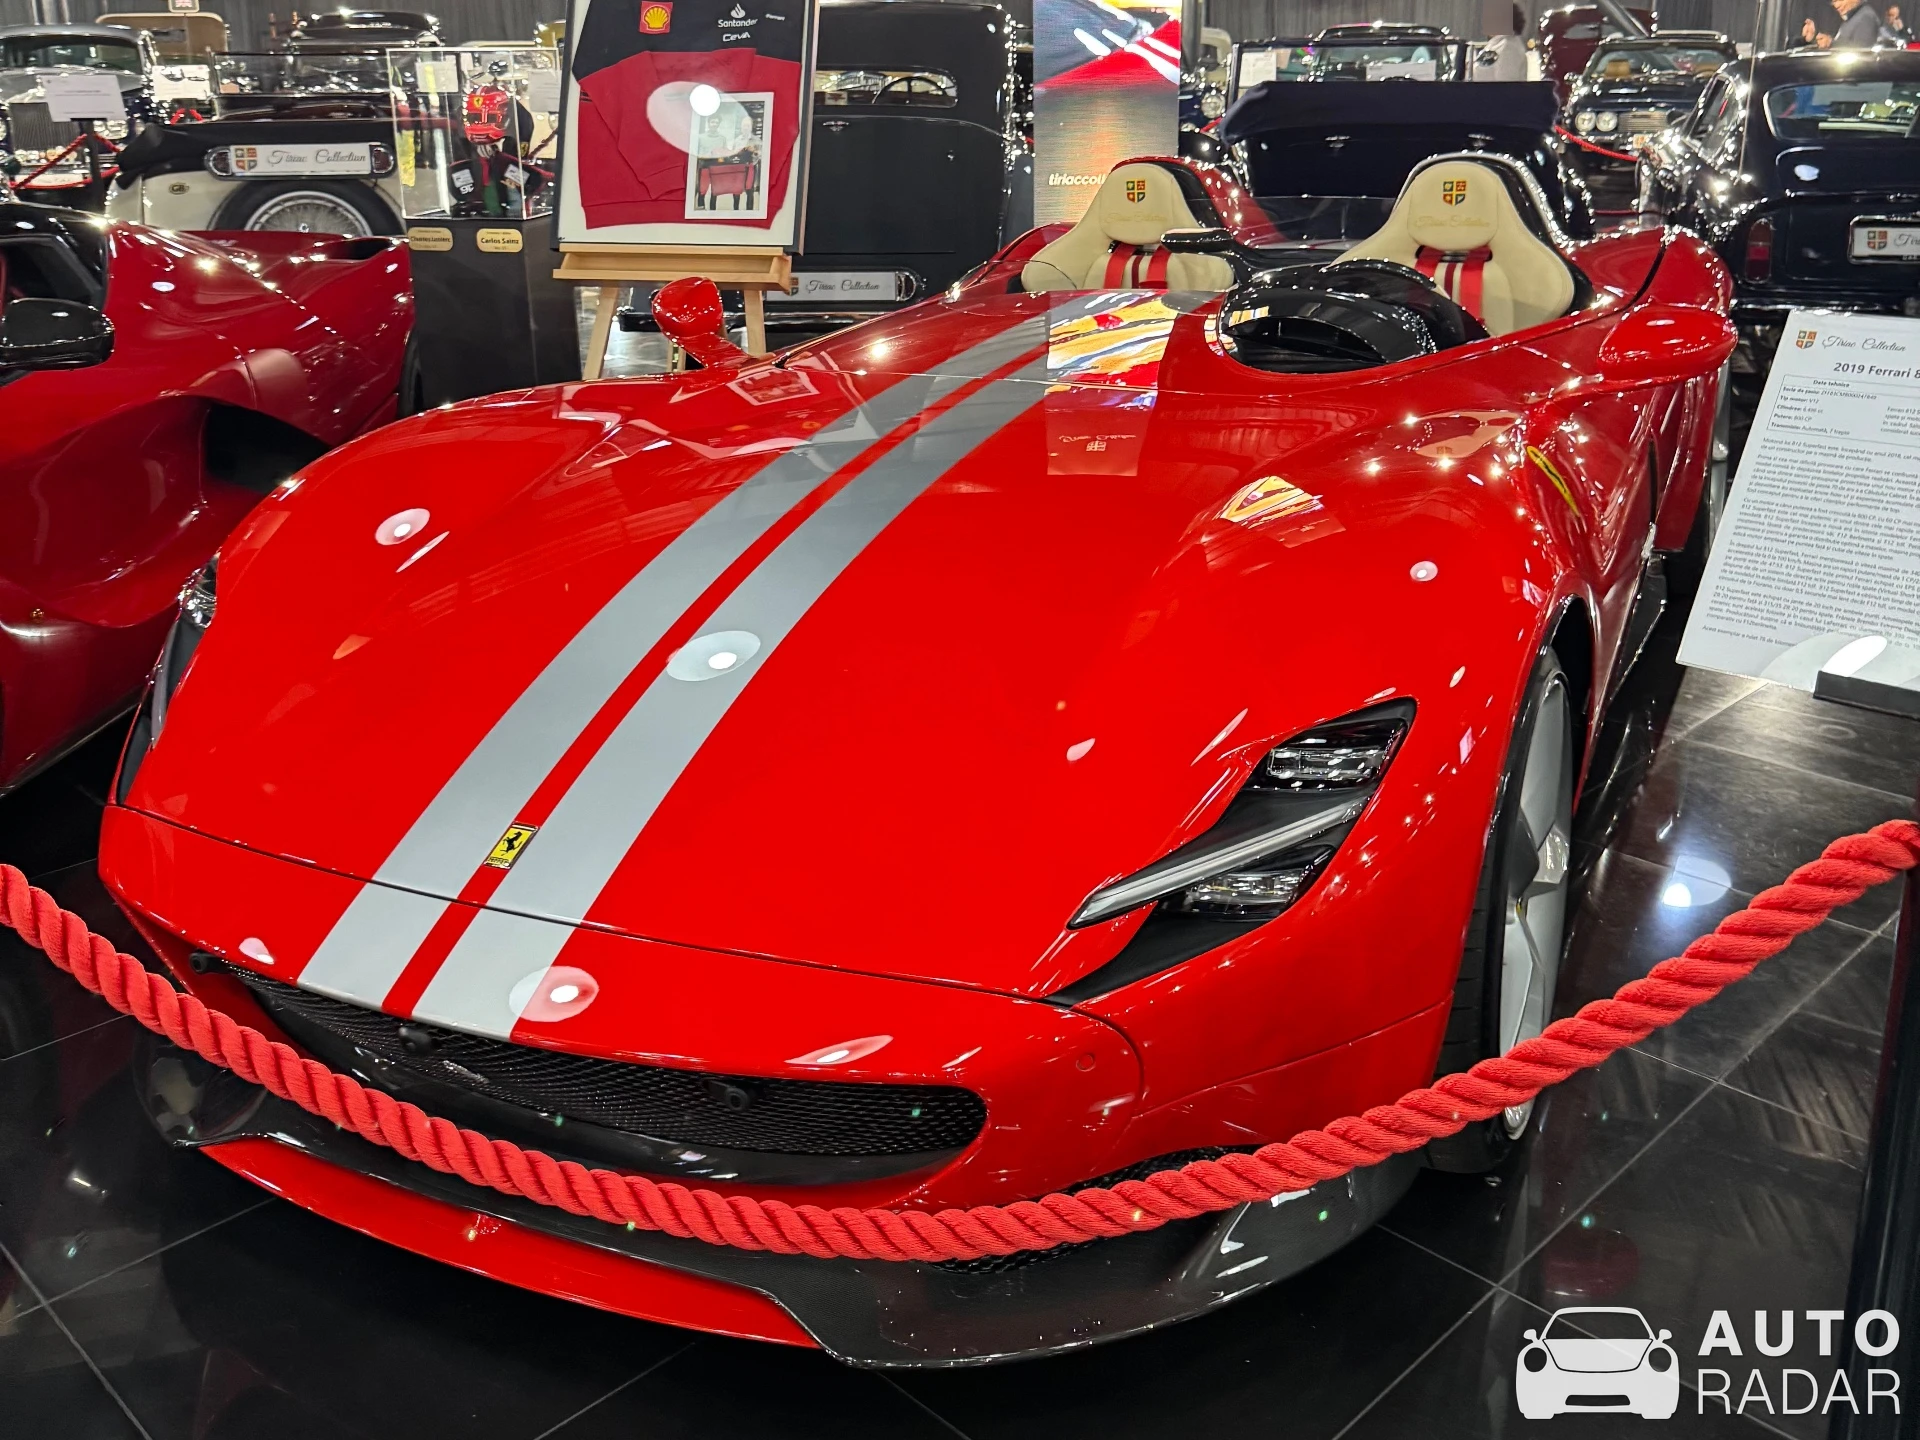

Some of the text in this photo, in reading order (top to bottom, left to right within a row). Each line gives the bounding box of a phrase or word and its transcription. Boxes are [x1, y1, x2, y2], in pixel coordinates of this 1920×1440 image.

[717, 18, 758, 28] Santander
[315, 148, 366, 164] Collection
[841, 279, 880, 292] Collection
[1862, 338, 1907, 352] Collection
[1833, 362, 1865, 374] 2019
[1868, 365, 1911, 378] Ferrari
